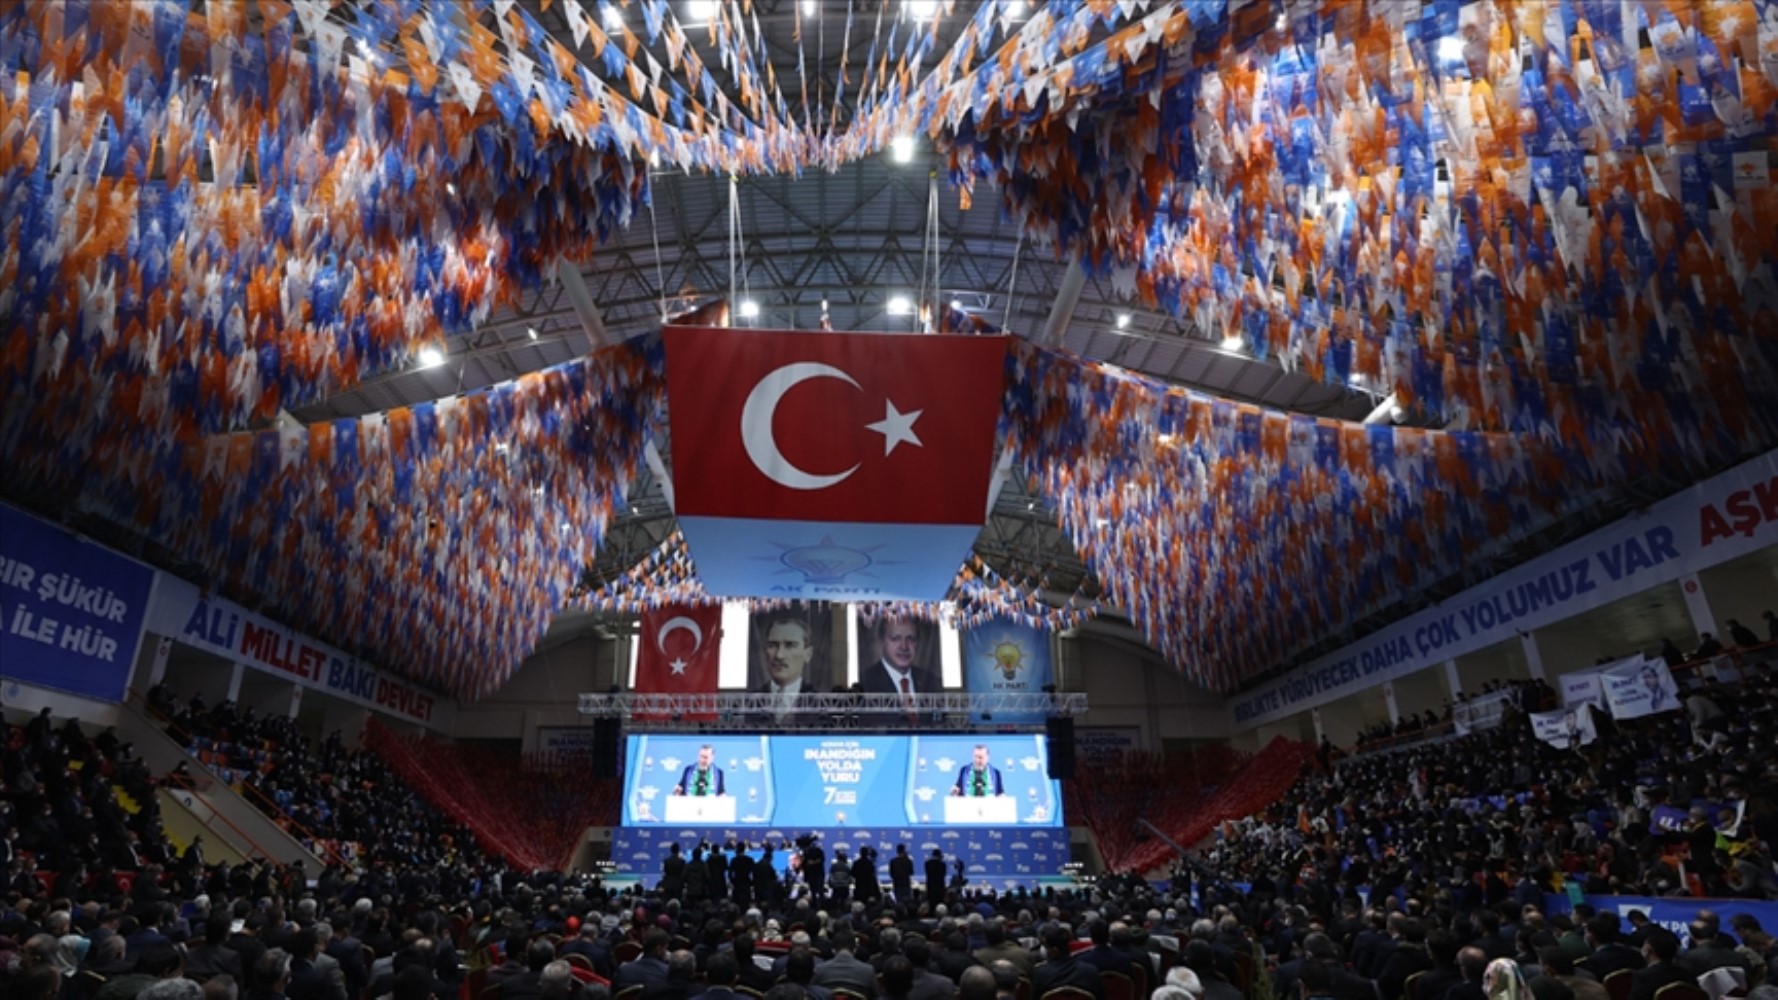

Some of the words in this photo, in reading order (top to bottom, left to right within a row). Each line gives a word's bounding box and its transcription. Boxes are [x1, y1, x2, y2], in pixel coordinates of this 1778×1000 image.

[37, 572, 128, 624] ŞÜKÜR
[1361, 635, 1414, 675] DAHA
[1415, 613, 1462, 658] ÇOK
[1460, 558, 1597, 635] YOLUMUZ
[1597, 525, 1681, 581] VAR
[9, 603, 59, 645] İLE
[59, 624, 118, 662] HÜR
[376, 677, 435, 721] DEVLET
[817, 760, 863, 771] YOLDA
